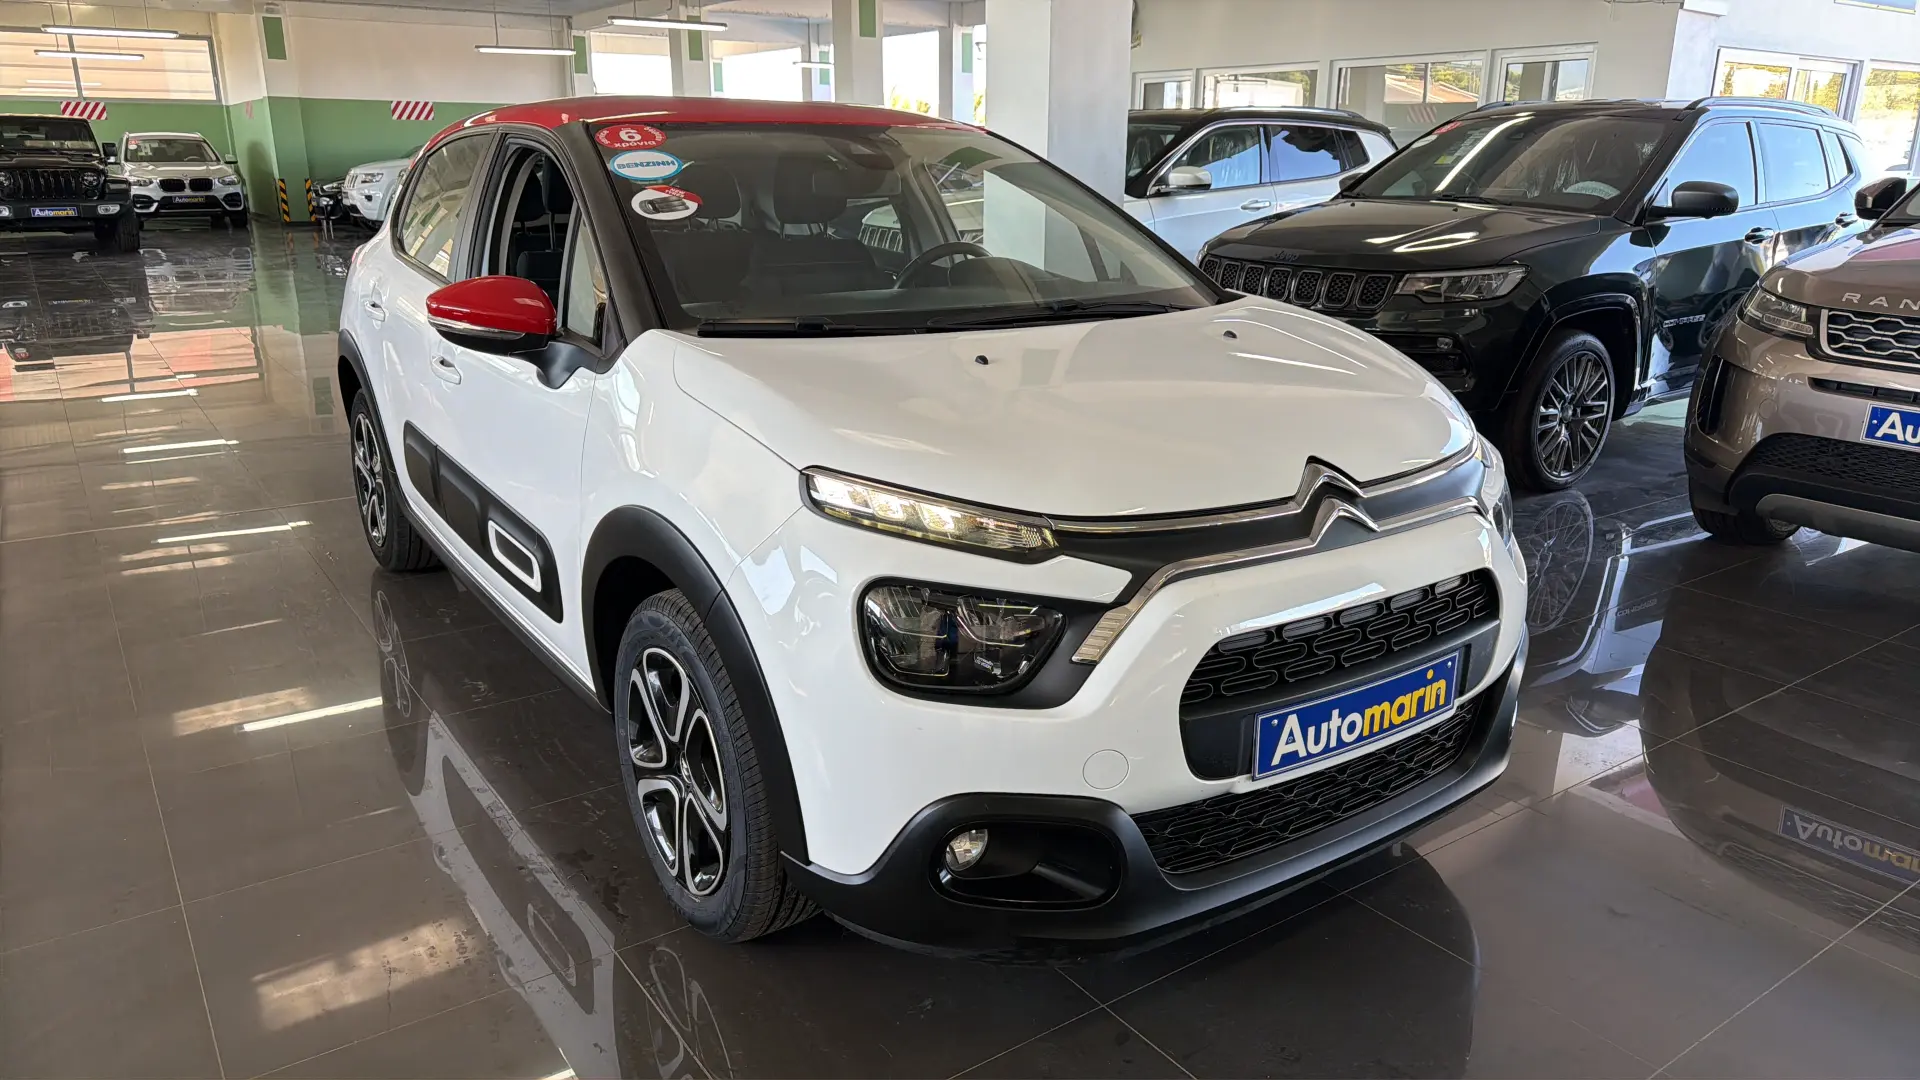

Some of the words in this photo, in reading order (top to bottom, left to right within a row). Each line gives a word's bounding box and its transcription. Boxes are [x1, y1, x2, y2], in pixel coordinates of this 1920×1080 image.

[619, 130, 642, 141] 6
[614, 140, 656, 148] χρόνια
[35, 207, 75, 216] Automarin
[1270, 668, 1447, 767] Automarin
